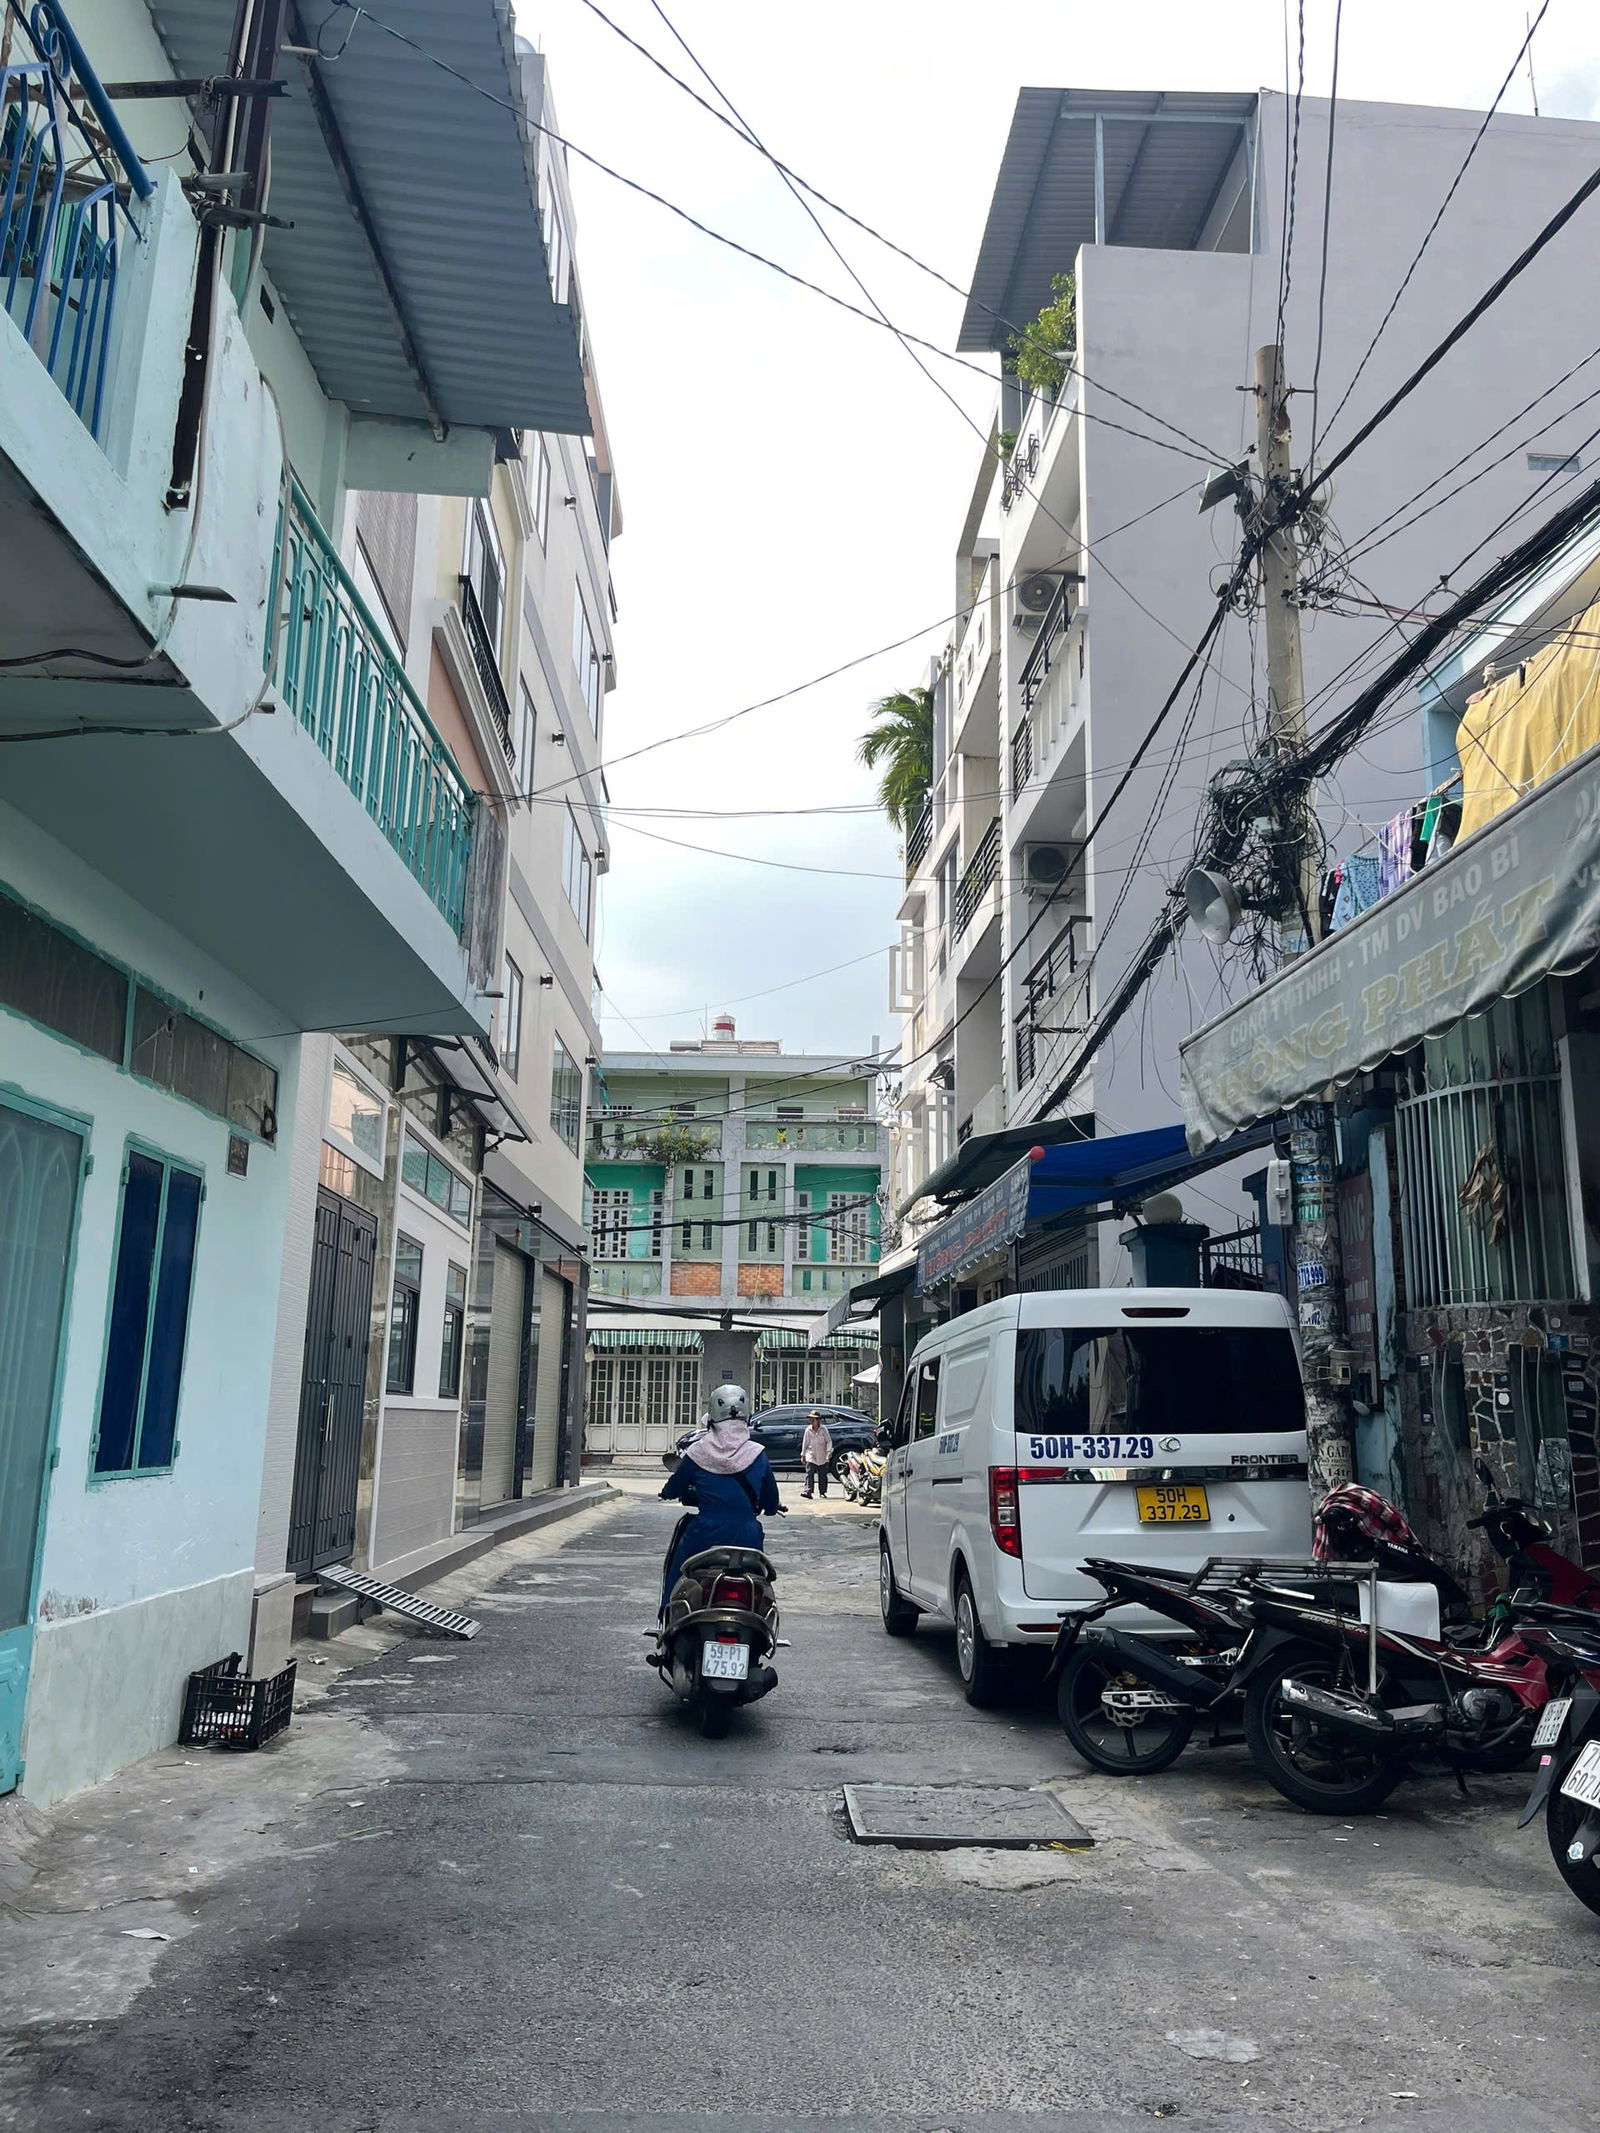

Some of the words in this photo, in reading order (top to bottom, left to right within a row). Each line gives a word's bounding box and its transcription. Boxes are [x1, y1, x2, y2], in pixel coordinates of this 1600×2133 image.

[1358, 923, 1390, 966] TM
[1397, 902, 1424, 943] DV
[1433, 863, 1482, 920] BAO
[1361, 873, 1555, 1035] PHÁT
[1030, 1436, 1154, 1459] 50H-337.29
[1231, 1454, 1299, 1465] FRONTIER
[1156, 1488, 1187, 1504] 50H
[1146, 1505, 1202, 1521] 337.29
[710, 1645, 741, 1661] 59-P1
